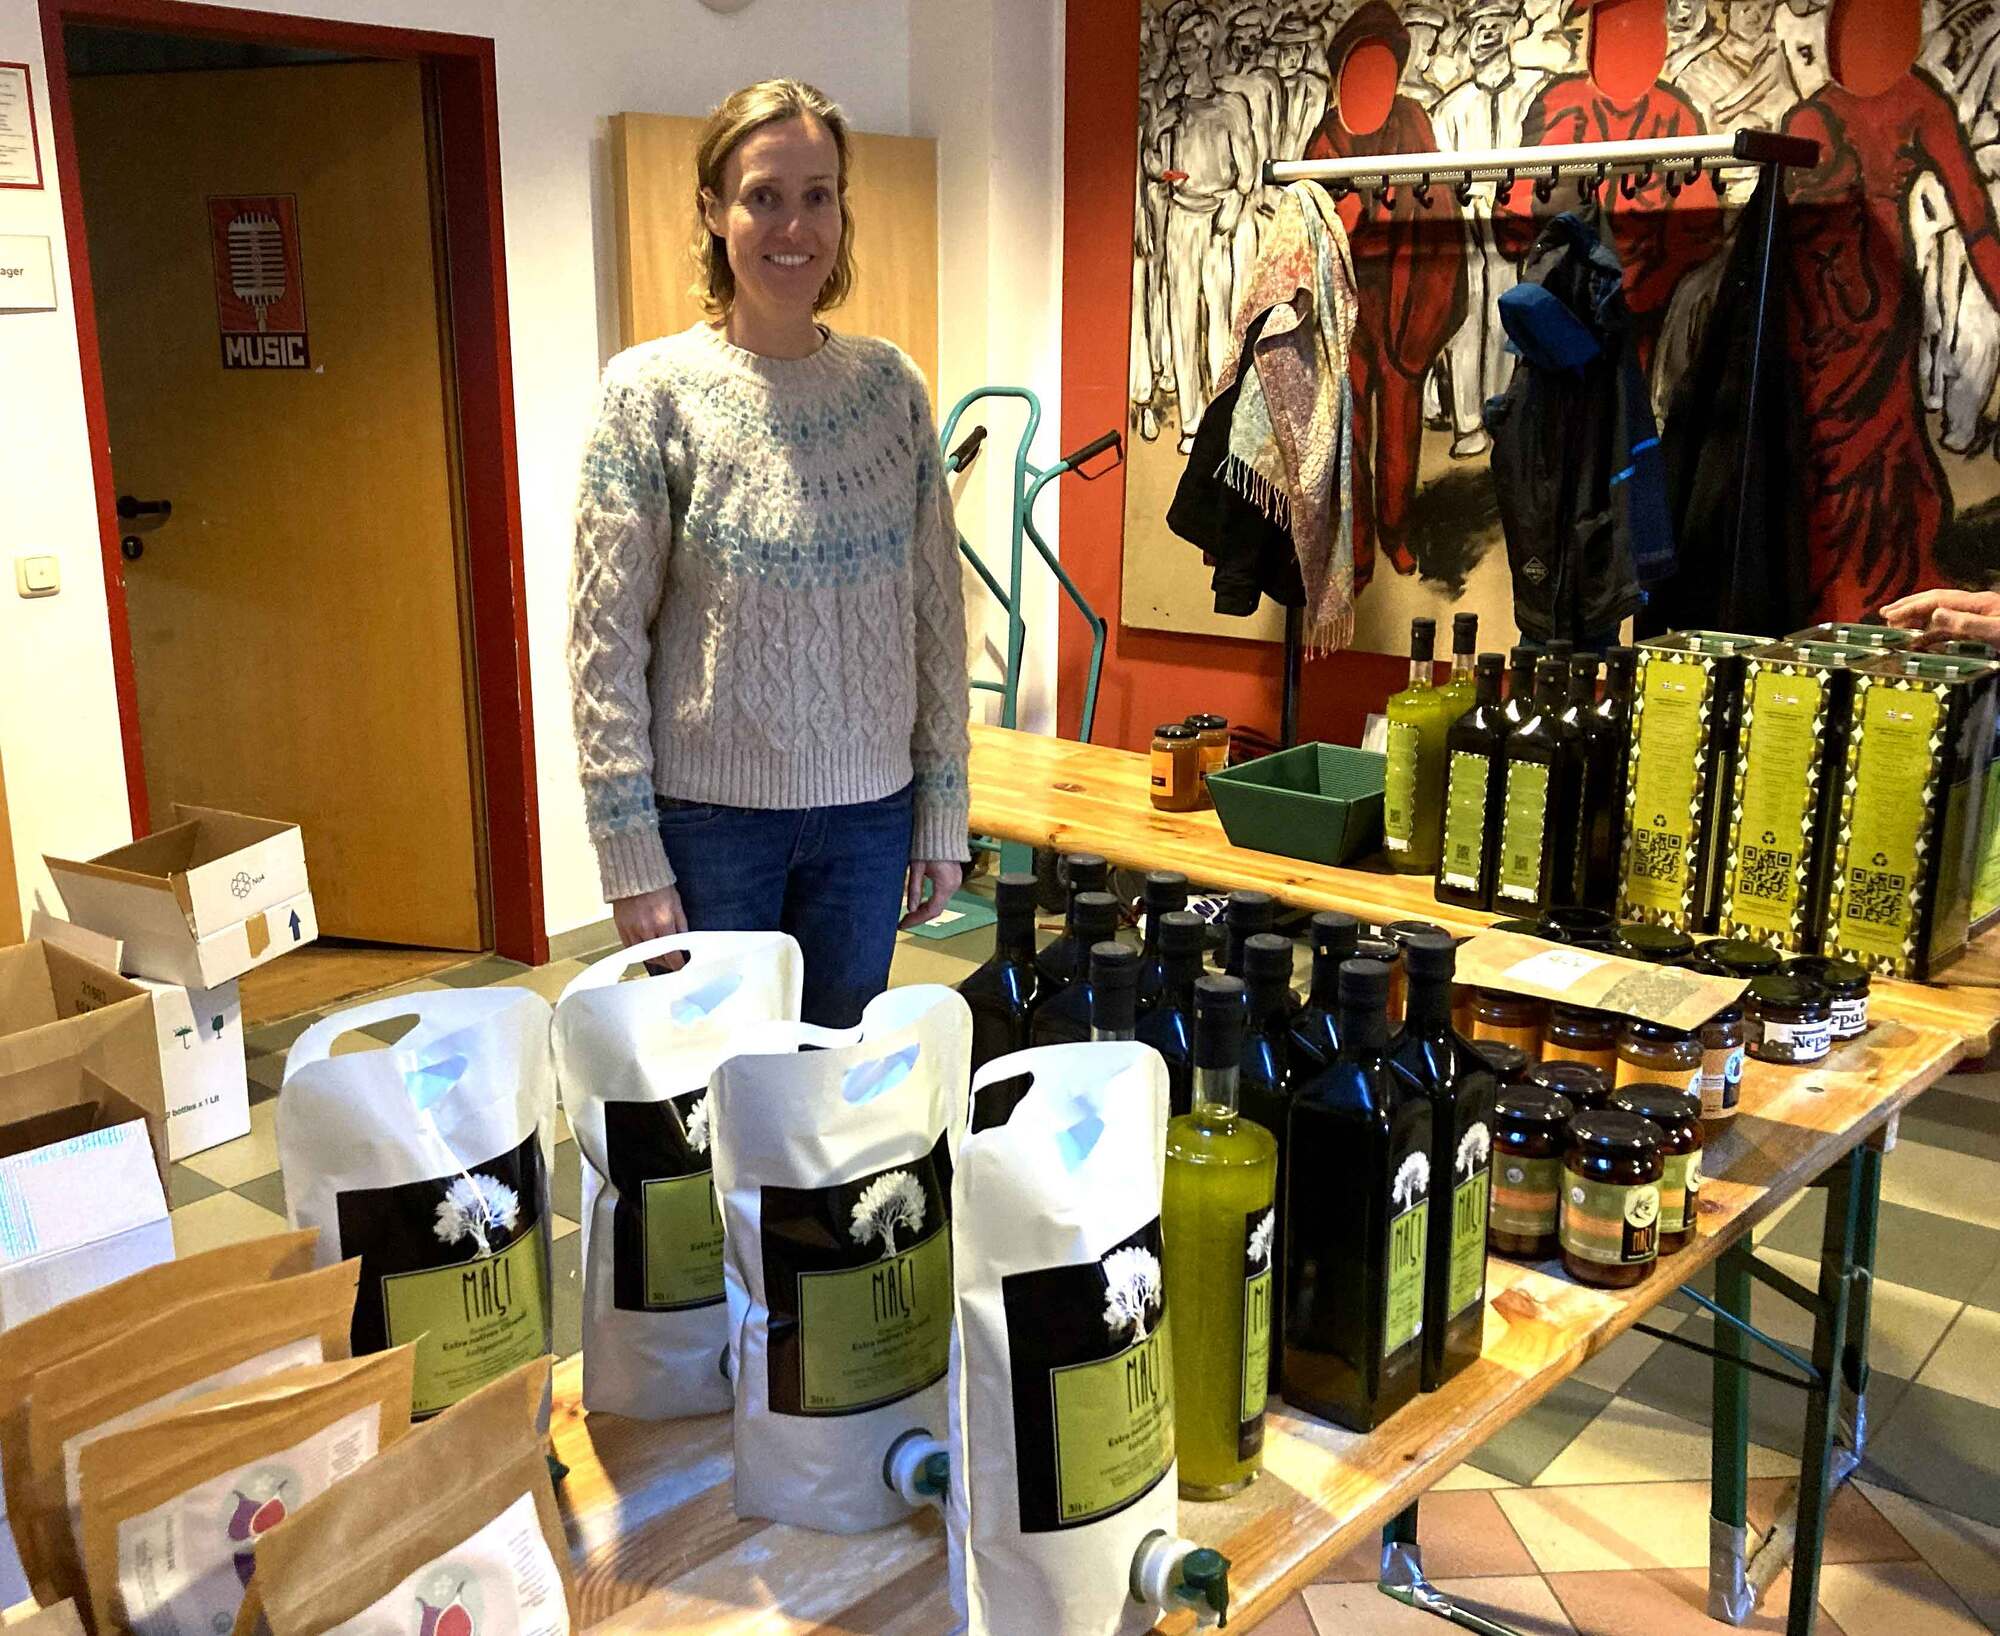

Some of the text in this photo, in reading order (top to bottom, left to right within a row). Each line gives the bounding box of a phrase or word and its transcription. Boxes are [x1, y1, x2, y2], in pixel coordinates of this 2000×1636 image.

[225, 336, 305, 366] MUSIC
[1457, 1181, 1483, 1239] MAÇI
[1394, 1213, 1422, 1272] MAÇI
[462, 1258, 512, 1322] MAÇI
[872, 1258, 916, 1323] MAÇI
[442, 1339, 468, 1351] Extra
[1126, 1338, 1160, 1413] MAÇI
